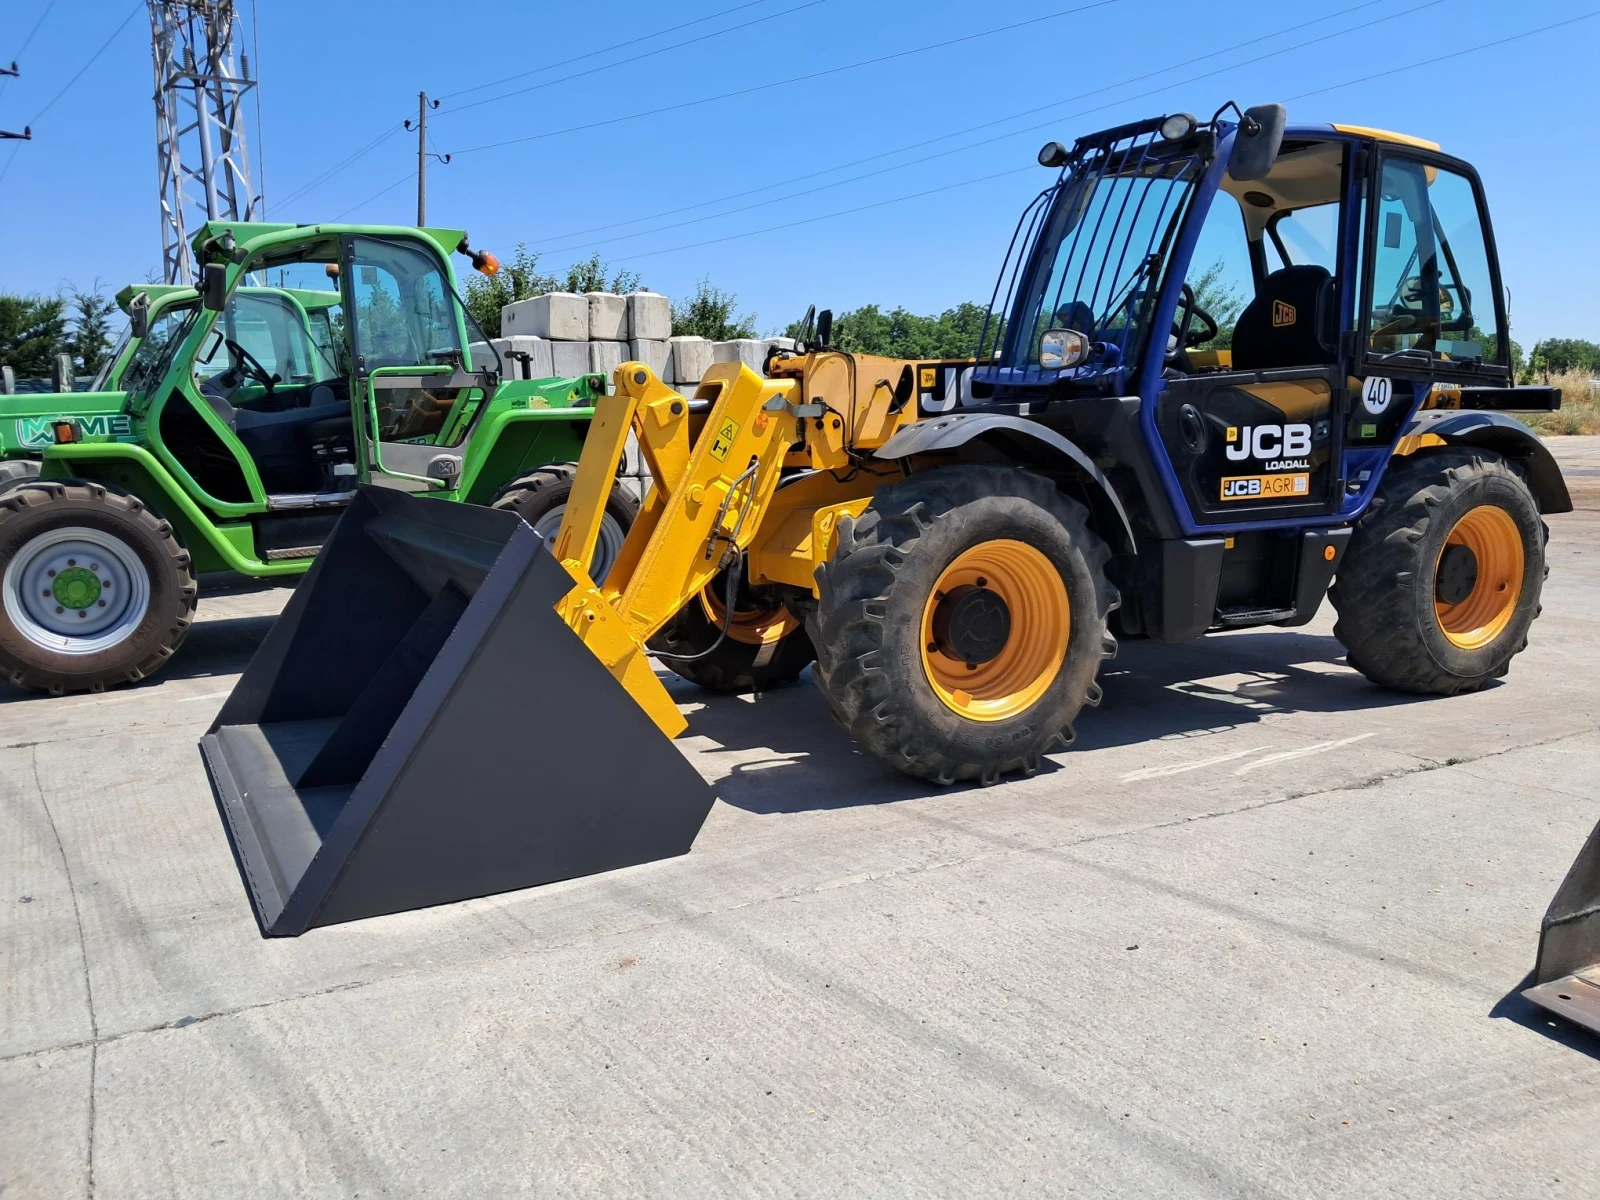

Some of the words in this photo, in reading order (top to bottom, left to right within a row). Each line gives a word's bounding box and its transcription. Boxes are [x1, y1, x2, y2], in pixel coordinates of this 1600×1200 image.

[1275, 304, 1294, 323] JCB
[920, 366, 997, 412] JC
[1366, 378, 1387, 406] 40
[1226, 423, 1312, 461] JCB
[1265, 459, 1310, 471] LOADALL
[1223, 479, 1261, 496] JCB
[1262, 477, 1294, 494] AGRI
